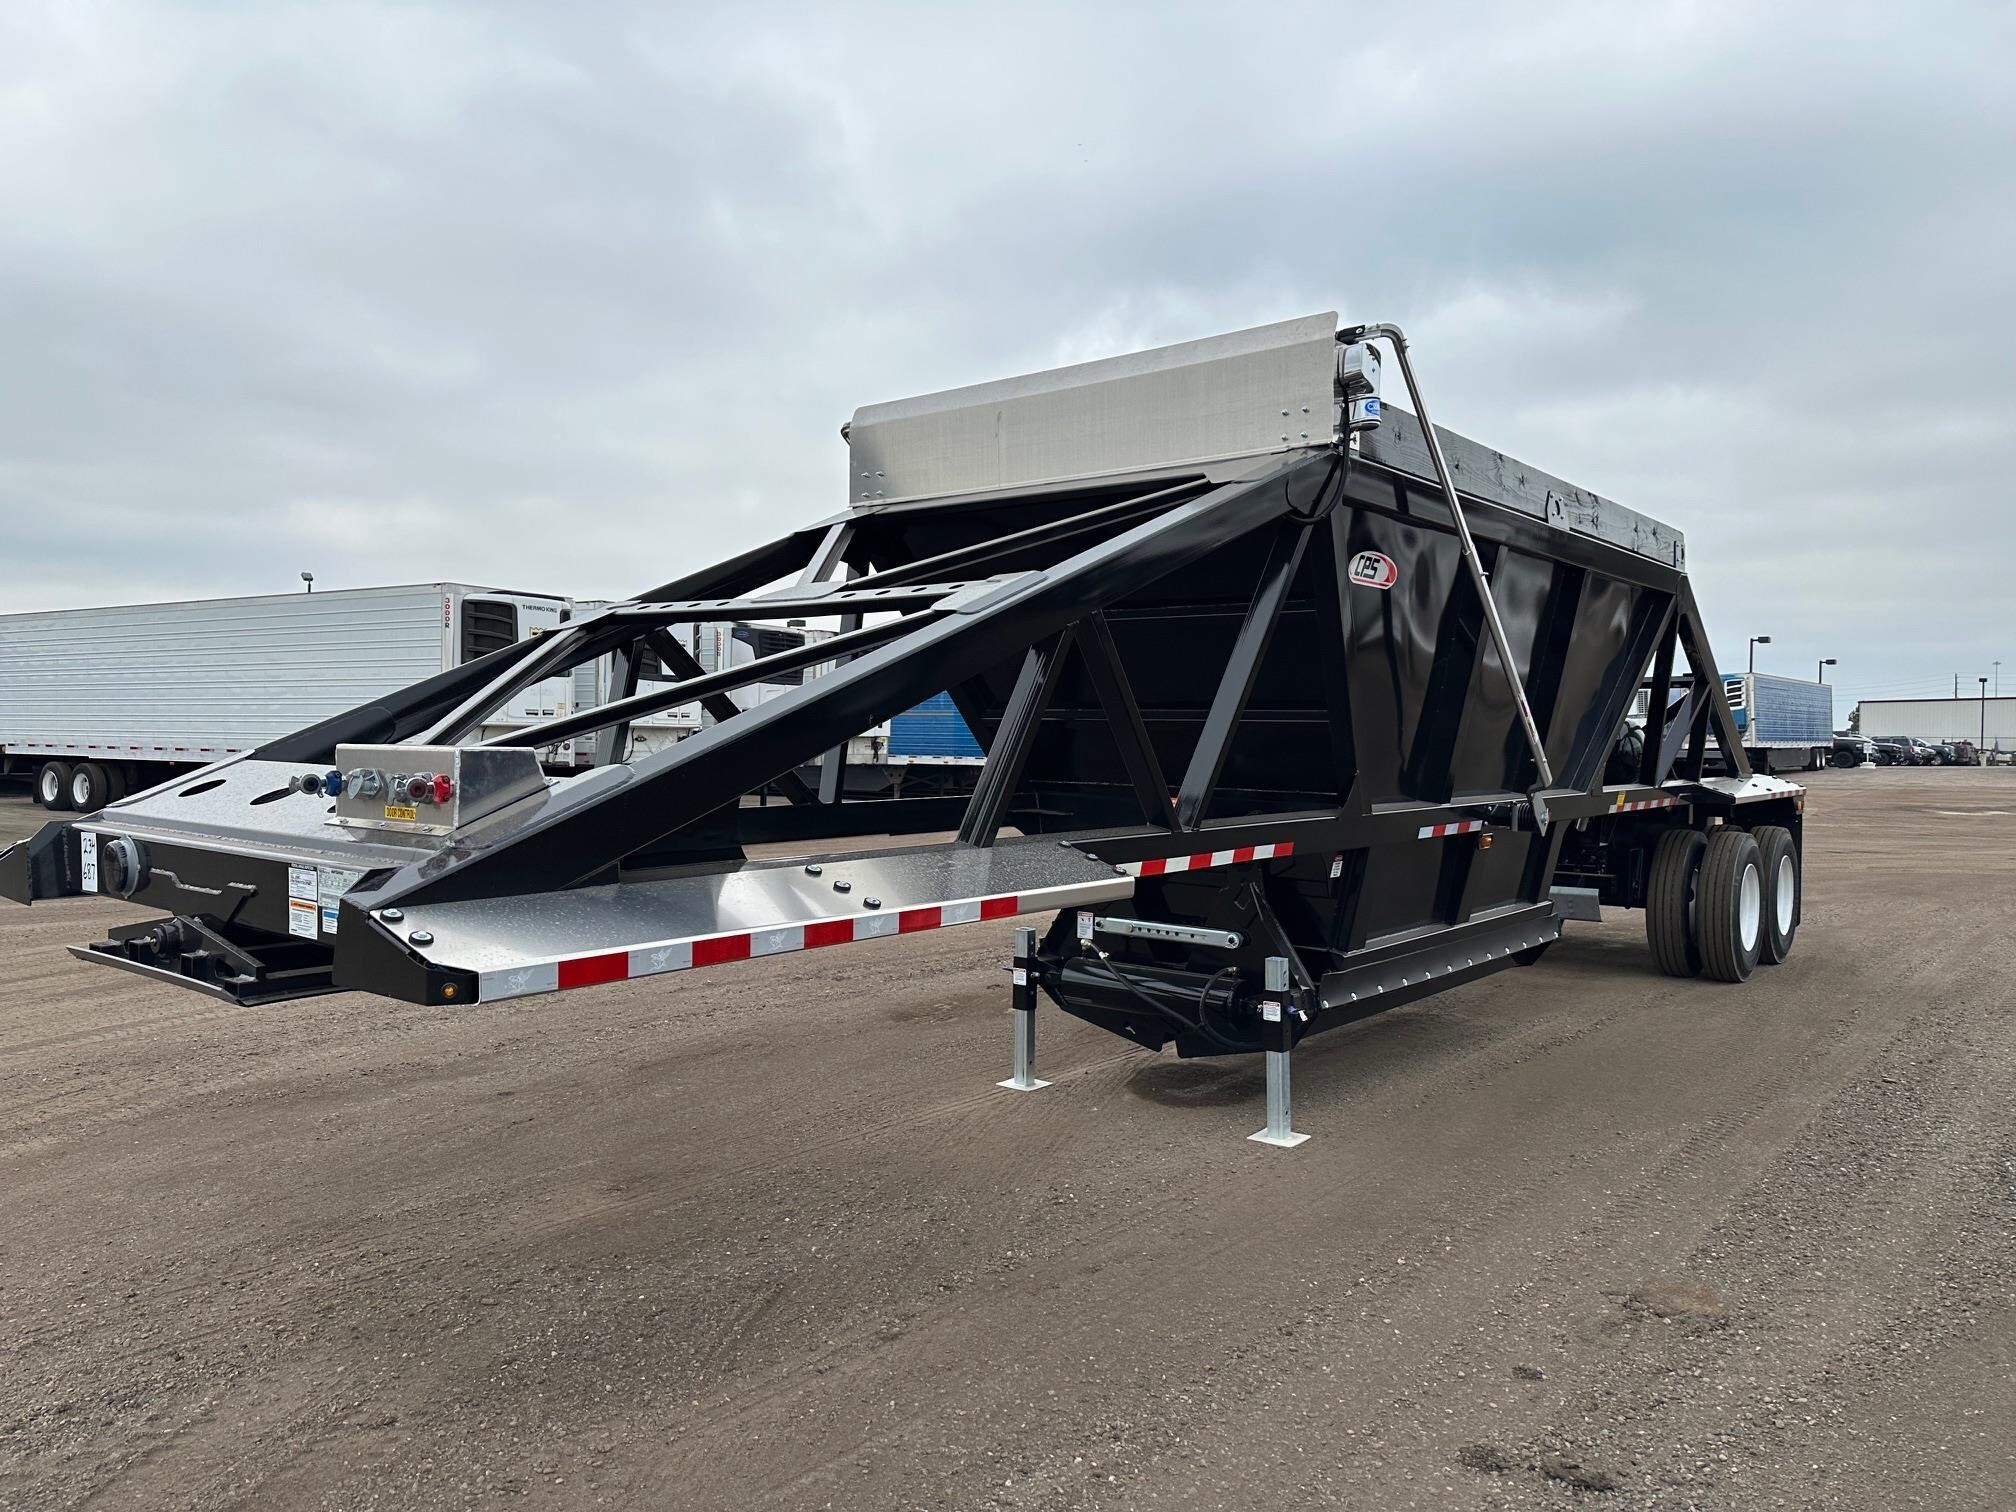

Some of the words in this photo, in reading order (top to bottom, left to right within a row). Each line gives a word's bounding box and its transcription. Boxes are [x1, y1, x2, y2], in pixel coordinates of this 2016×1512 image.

[1354, 555, 1380, 579] CPS
[522, 604, 545, 612] THERMO
[386, 806, 397, 818] DOOR
[397, 808, 415, 820] CONTROL
